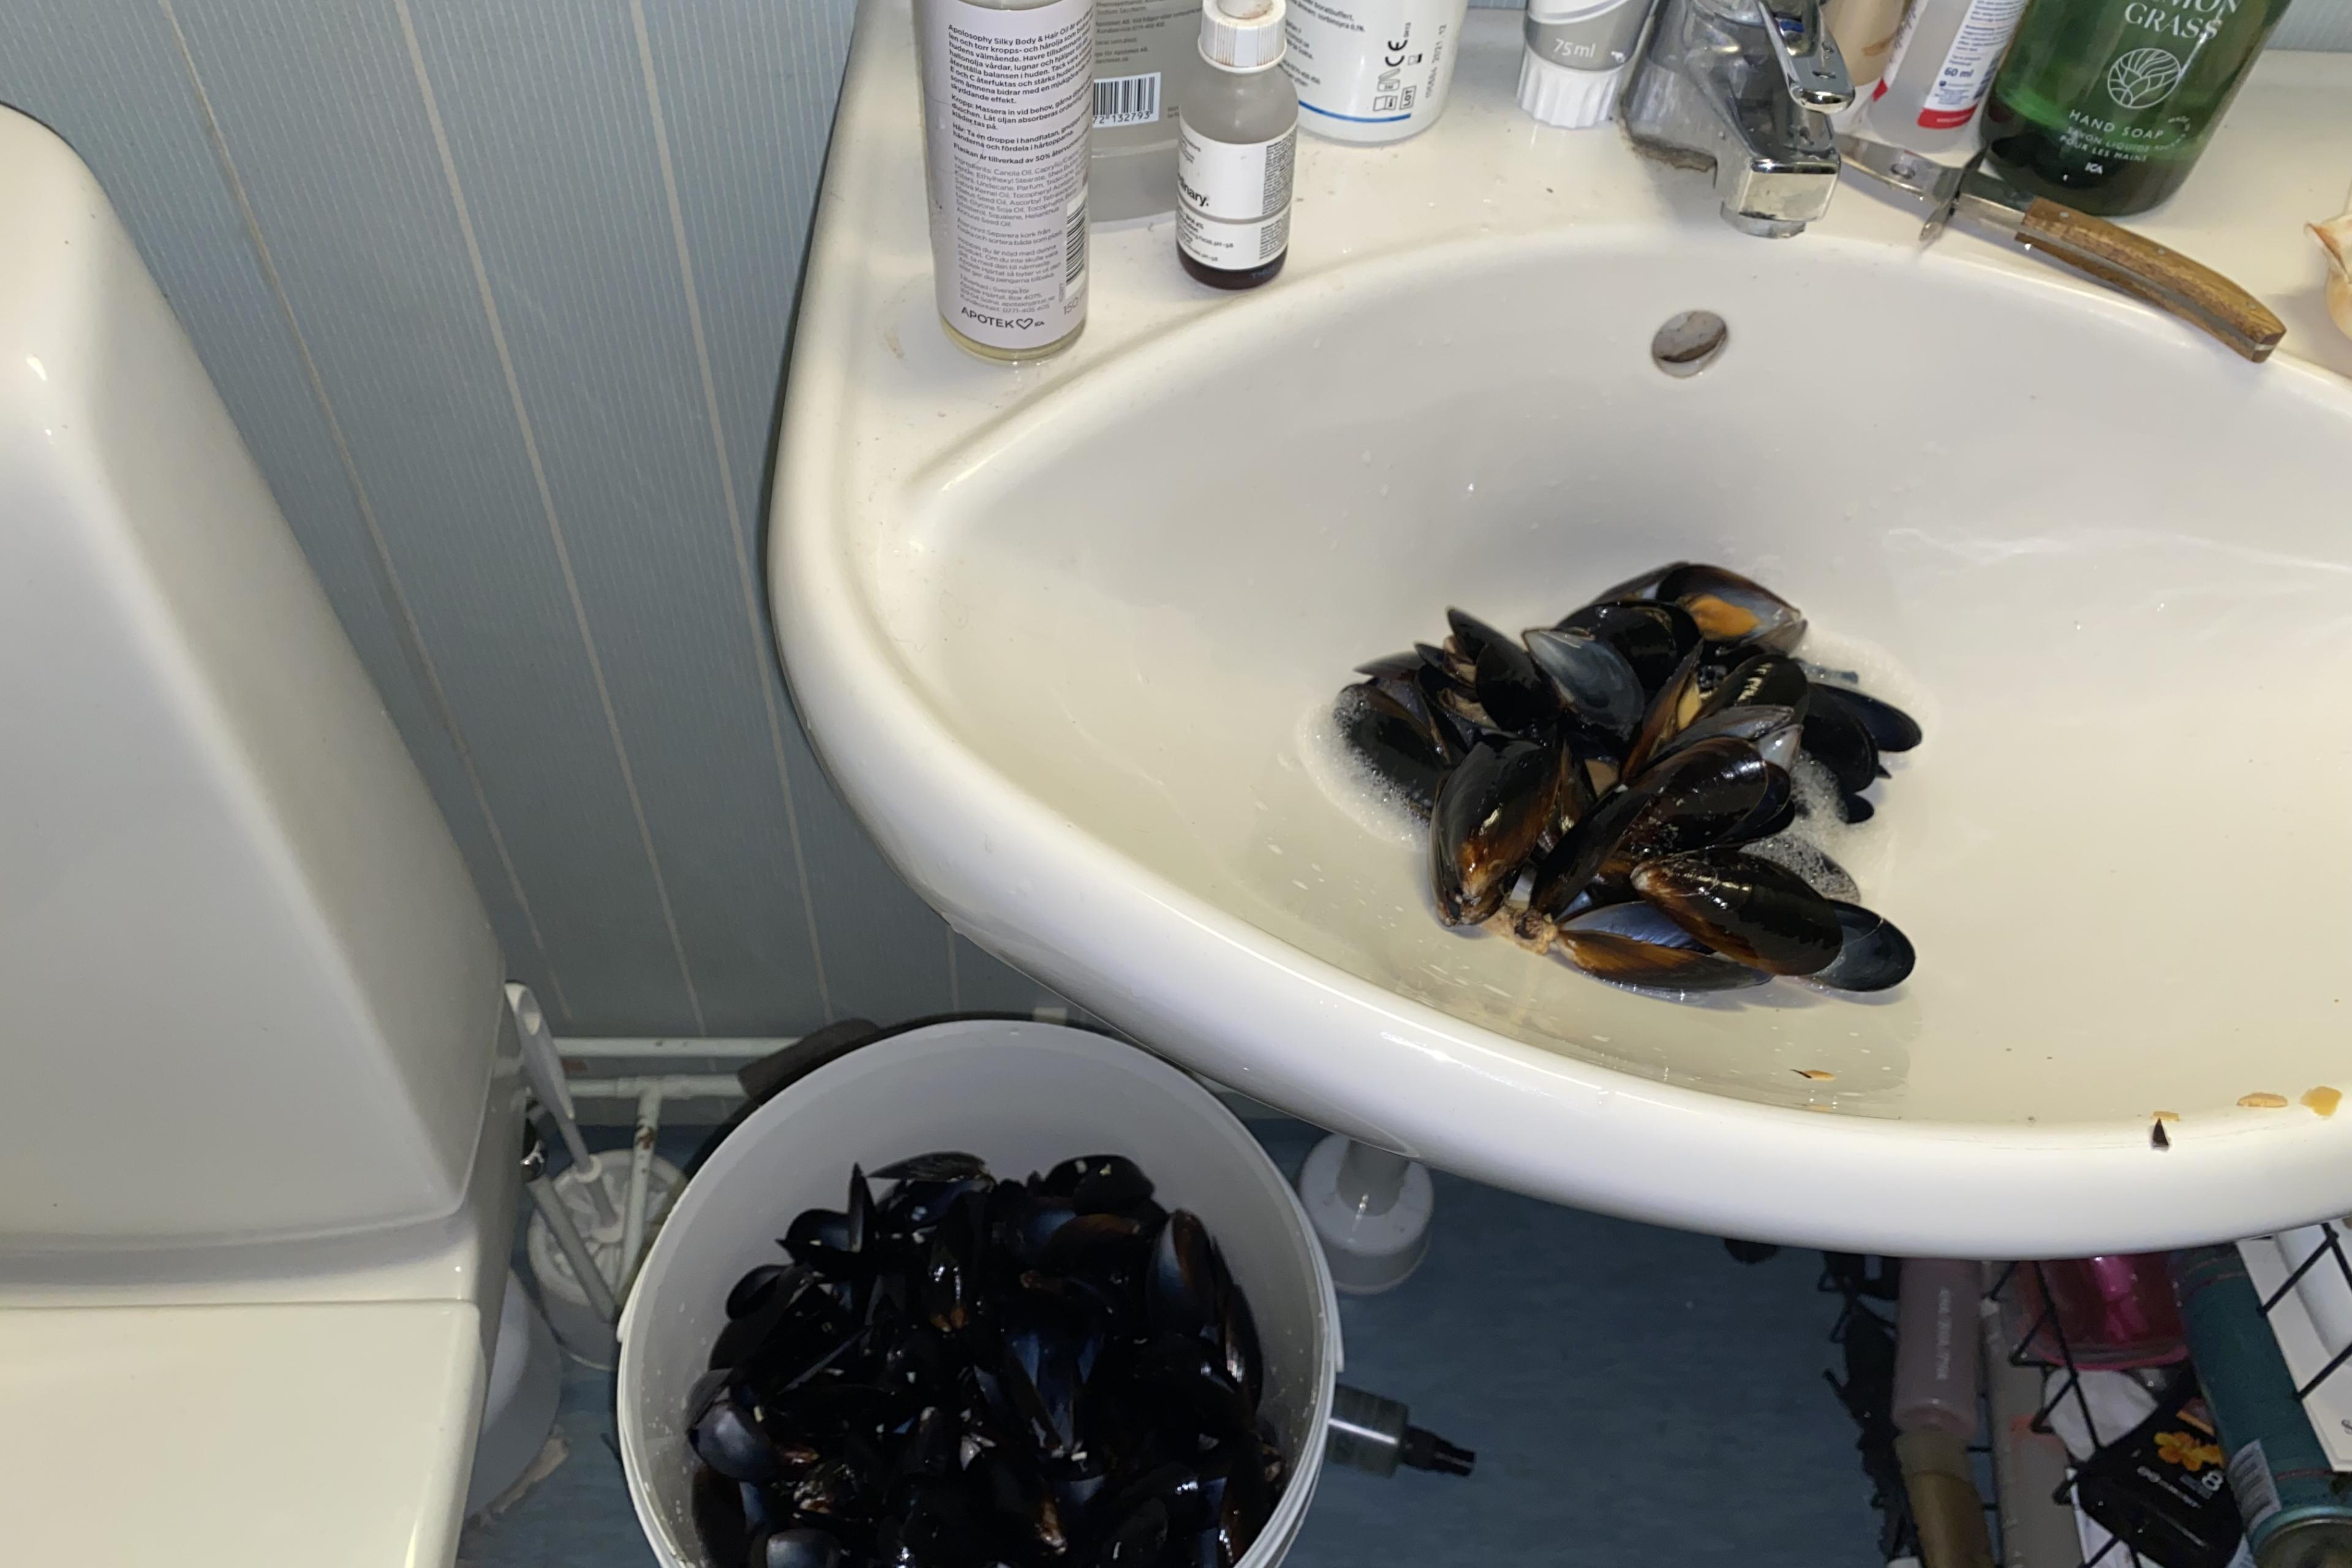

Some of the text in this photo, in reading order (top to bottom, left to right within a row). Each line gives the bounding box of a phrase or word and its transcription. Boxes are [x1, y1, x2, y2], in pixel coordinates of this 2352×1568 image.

[2125, 2, 2223, 40] GRASS
[948, 24, 992, 45] Apolosophy
[1044, 31, 1058, 40] Hair
[1060, 26, 1069, 35] Oil
[949, 32, 959, 42] len
[991, 46, 1022, 55] kropps-
[1039, 39, 1063, 50] hårolja
[1065, 32, 1076, 42] som
[949, 40, 974, 56] hudens
[976, 53, 1021, 62] välmående.
[1047, 36, 1081, 57] tillsammans
[949, 48, 983, 67] hallonolja
[985, 62, 1012, 72] vårdar,
[1014, 63, 1039, 72] lugnar
[1055, 48, 1075, 63] hjälper
[950, 57, 982, 75] återställa
[984, 70, 1019, 79] balansen
[1025, 69, 1050, 78] huden.
[1052, 62, 1066, 72] Tack
[956, 70, 968, 79] och
[976, 76, 1016, 87] återfuktas
[1034, 75, 1055, 85] stärks
[1056, 66, 1074, 78] huden
[1944, 67, 1975, 78] 60 ml
[951, 75, 964, 85] som
[966, 81, 995, 94] ämnena
[951, 83, 989, 101] skyddande
[951, 94, 974, 108] Kropp:
[975, 104, 1006, 115] Massera
[1030, 104, 1054, 115] behov,
[1055, 95, 1072, 108] gärna
[1403, 89, 1412, 107] LOT
[952, 103, 982, 119] duschen.
[1018, 110, 1058, 123] absorberas
[952, 109, 972, 123] kläder
[2069, 109, 2115, 133] HAND
[2122, 126, 2165, 140] SOAP
[953, 130, 984, 148] händerna
[987, 135, 1015, 144] droppe
[1020, 130, 1060, 143] handflatan,
[954, 142, 978, 158] Flaskan
[1035, 153, 1050, 162] 50%
[2060, 134, 2149, 162] POUR LES MAINS
[976, 172, 1014, 184] Ethylhexyl
[2084, 162, 2104, 176] ICA
[975, 186, 997, 197] Kernel
[1013, 187, 1052, 198] Tocopheryl
[977, 194, 1041, 206] Seed Ascorbyl
[981, 217, 999, 225] Seed
[987, 229, 1019, 238] Separera
[1036, 244, 1056, 254] denna
[982, 266, 1005, 276] Hjärtat
[1019, 261, 1050, 270] närmaste
[1063, 296, 1079, 315] 150
[961, 306, 1014, 329] APOTEK
